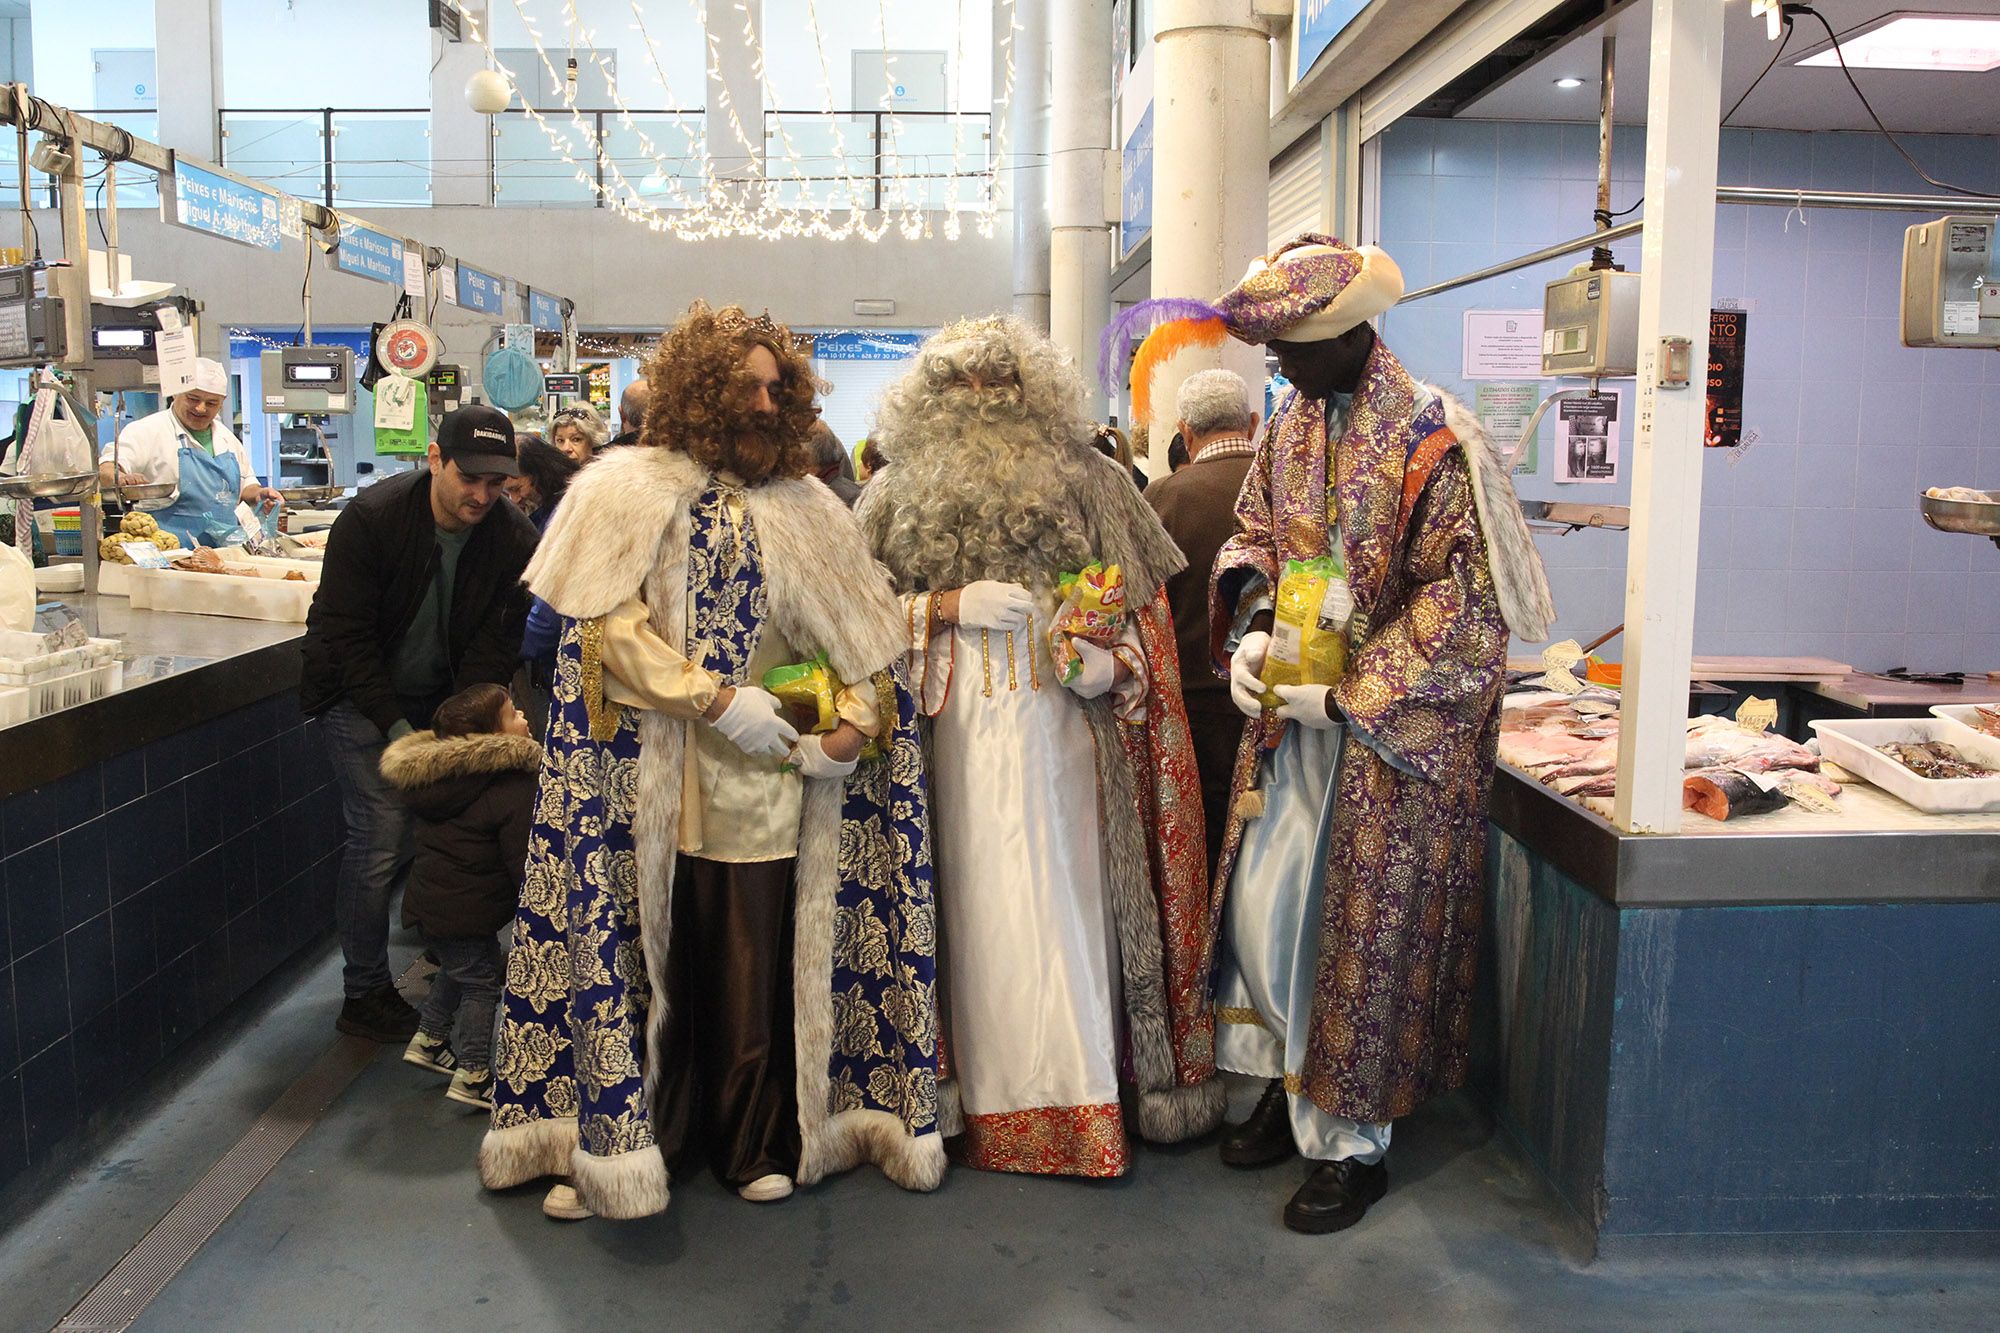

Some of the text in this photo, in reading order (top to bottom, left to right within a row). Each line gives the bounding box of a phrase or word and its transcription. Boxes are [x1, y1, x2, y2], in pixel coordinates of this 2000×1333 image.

[179, 173, 210, 199] Peixes
[211, 188, 217, 201] e
[184, 199, 211, 223] iguel
[1709, 314, 1737, 323] ERTO
[817, 341, 863, 353] Peixes
